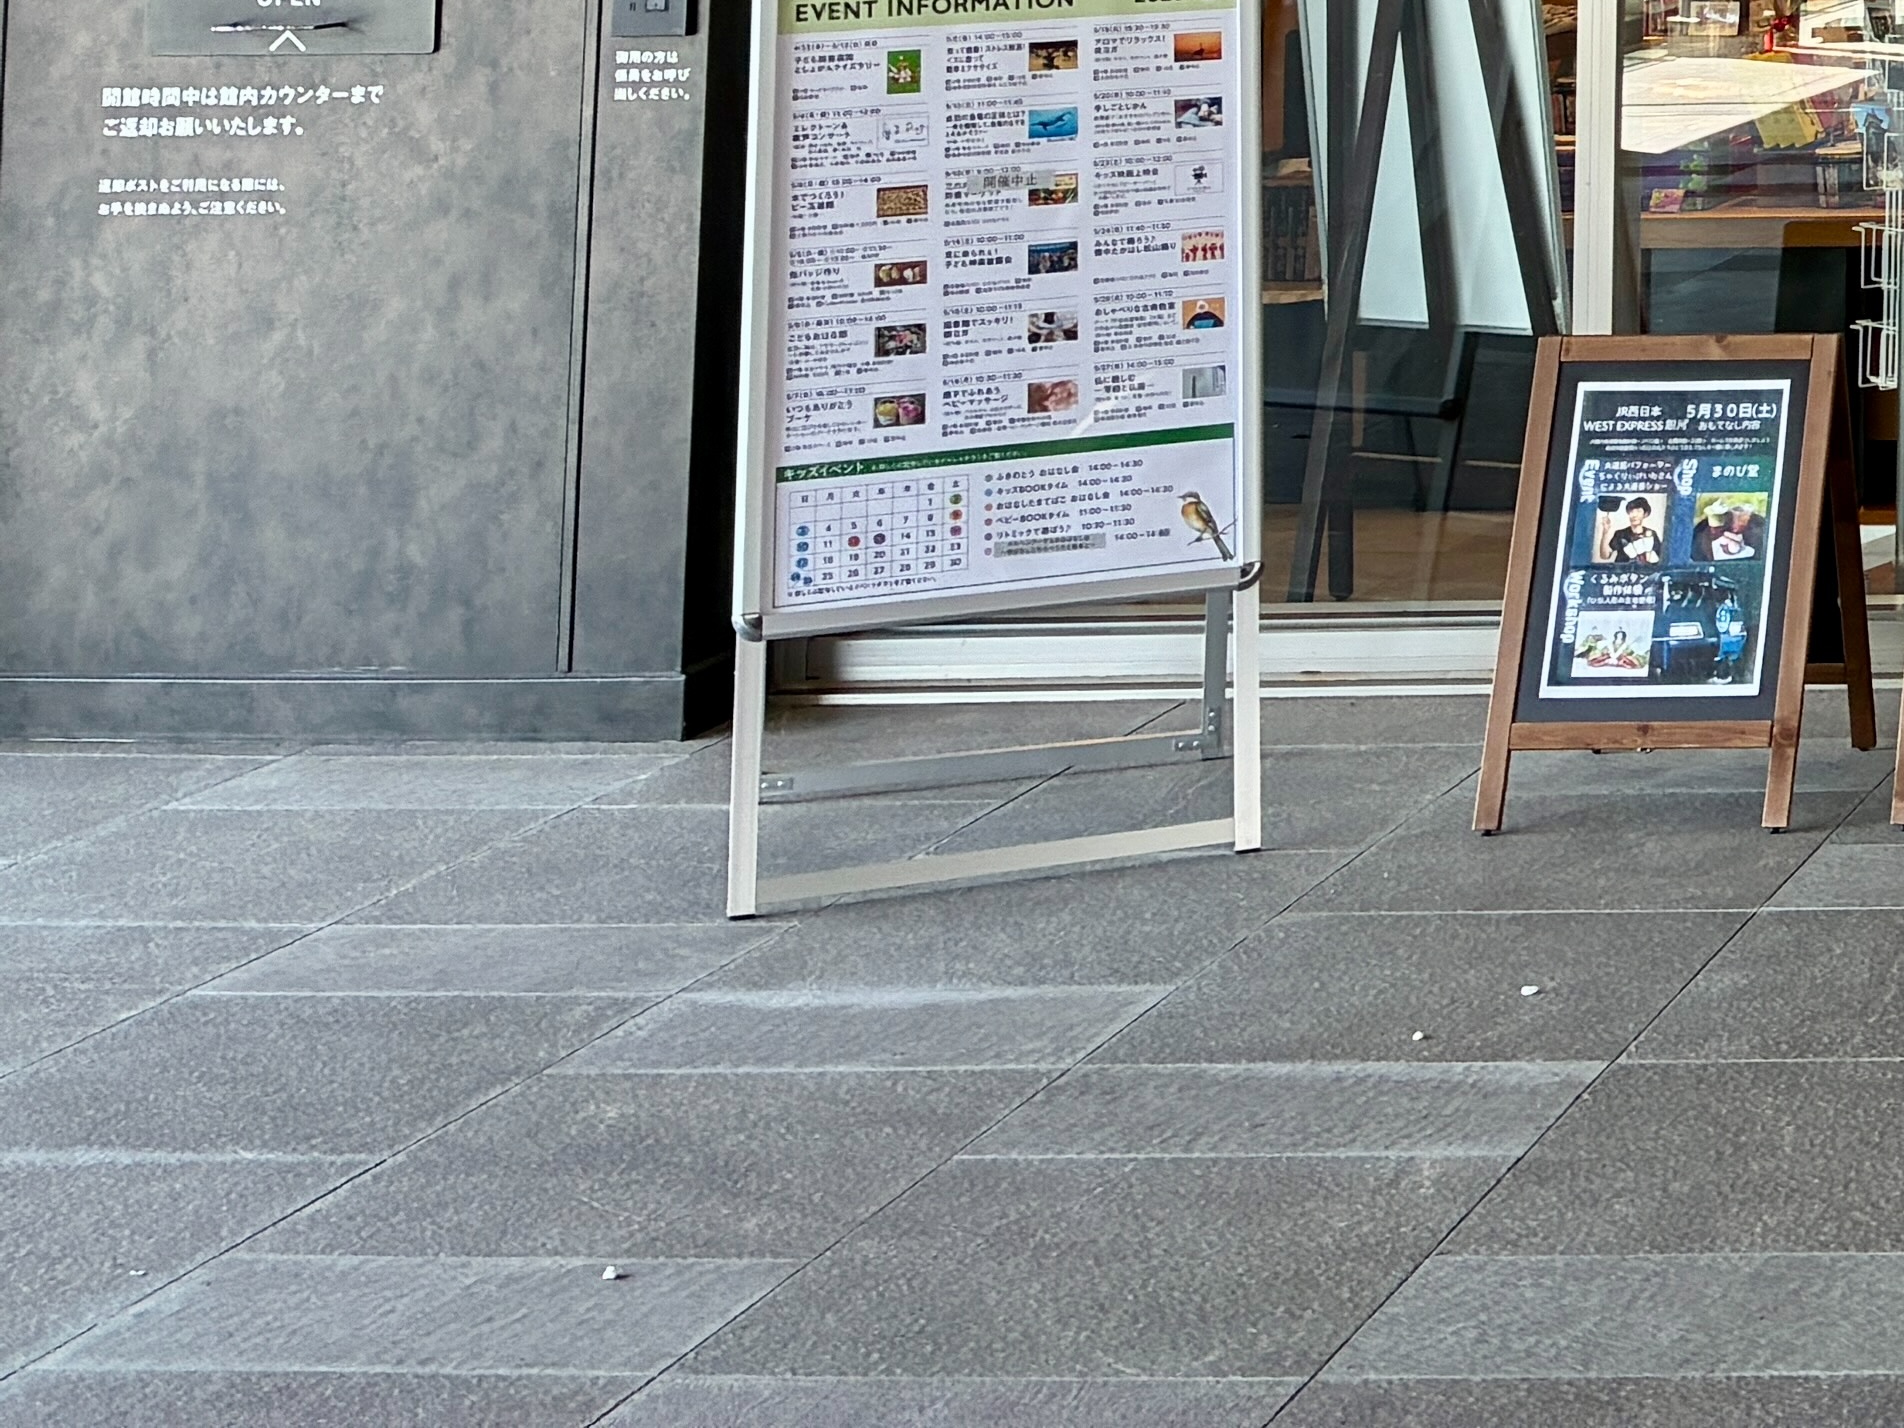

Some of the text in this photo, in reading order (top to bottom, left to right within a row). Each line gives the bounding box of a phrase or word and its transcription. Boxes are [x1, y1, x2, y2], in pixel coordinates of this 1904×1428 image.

[795, 0, 878, 22] EVENT
[615, 50, 678, 64] 御用の方は
[614, 68, 691, 83] 係員をお呼び
[101, 85, 384, 107] 開館時間中は館内カウンターまで
[102, 115, 304, 138] ご返却お願いいたします。
[983, 173, 1037, 189] 開催中止
[1615, 405, 1663, 418] JR西日本
[1583, 421, 1613, 432] WEST
[1616, 419, 1664, 432] EXPRESS
[784, 463, 864, 481] キッズイベント
[1677, 458, 1698, 496] Shop
[1561, 570, 1585, 644] Workshop
